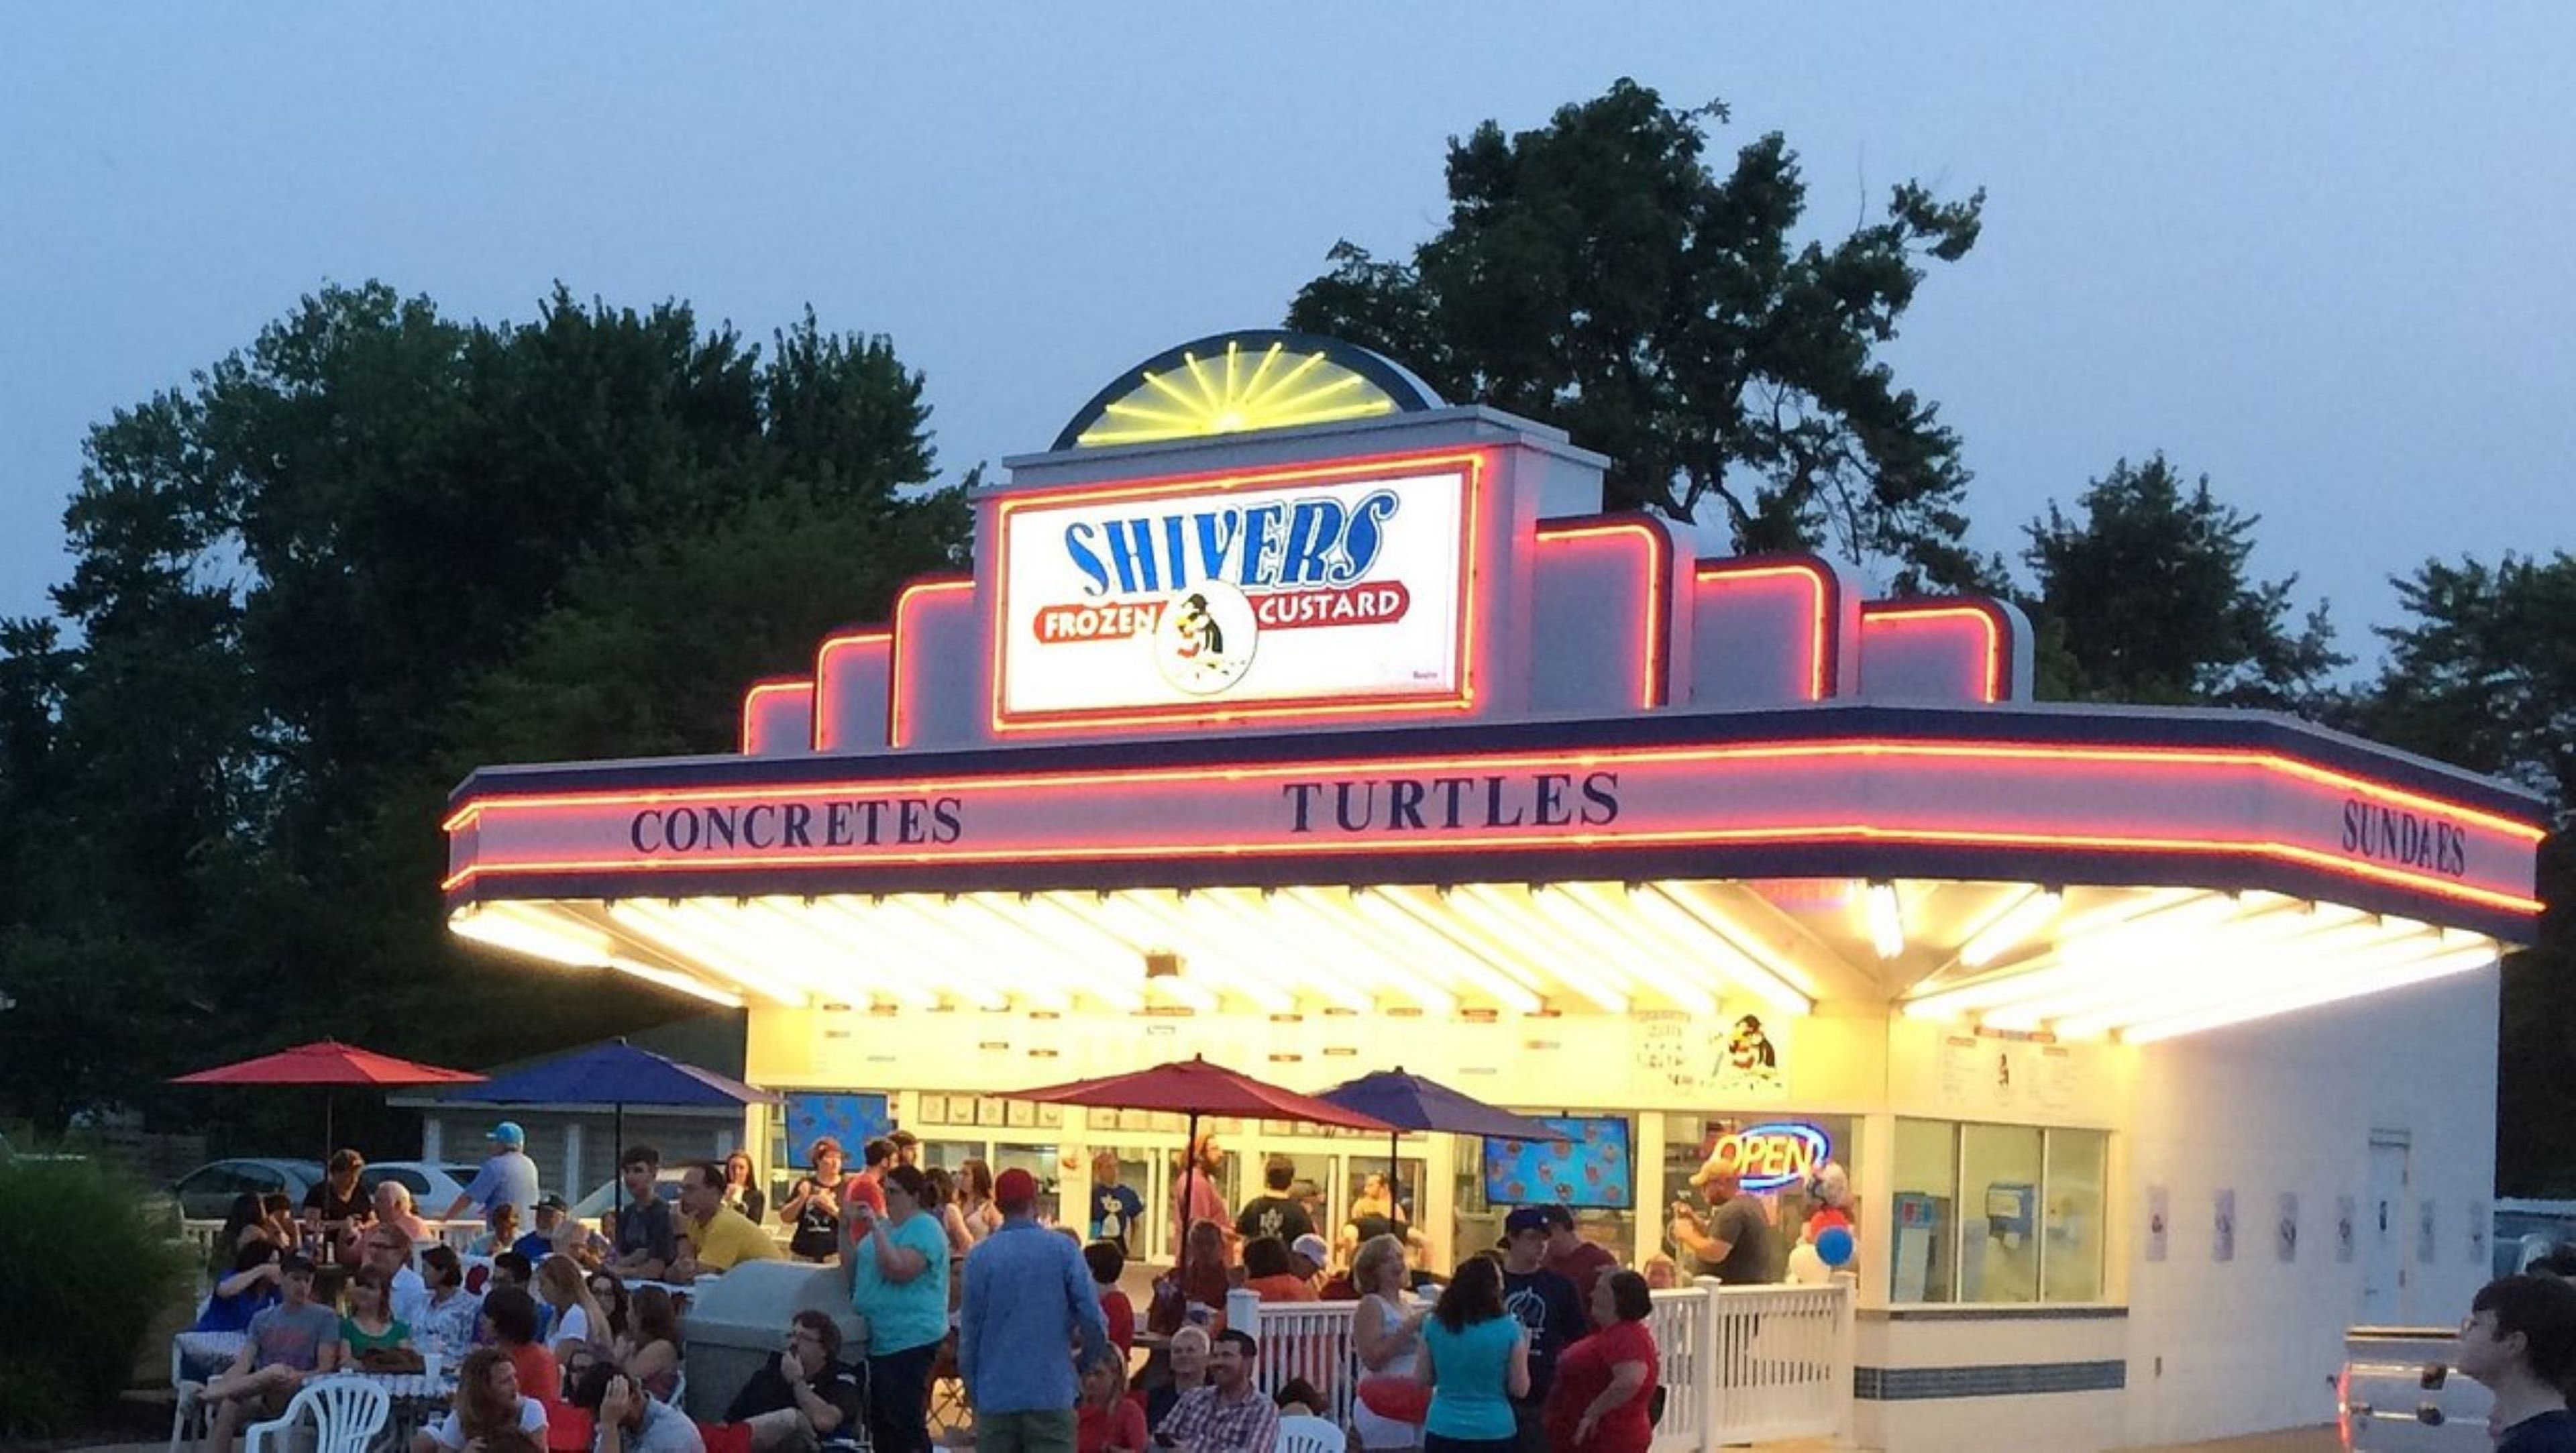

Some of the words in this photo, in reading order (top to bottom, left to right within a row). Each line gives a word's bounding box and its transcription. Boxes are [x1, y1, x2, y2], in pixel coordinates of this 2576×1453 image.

[1064, 489, 1400, 597] SHIVERS
[1044, 606, 1158, 639] FROZEN
[1258, 590, 1400, 624] CUSTARD
[631, 796, 963, 854] CONCRETES
[1282, 771, 1619, 833] TURTLES
[2342, 798, 2465, 877] SUNDAES
[1711, 1134, 1813, 1179] OPEN
